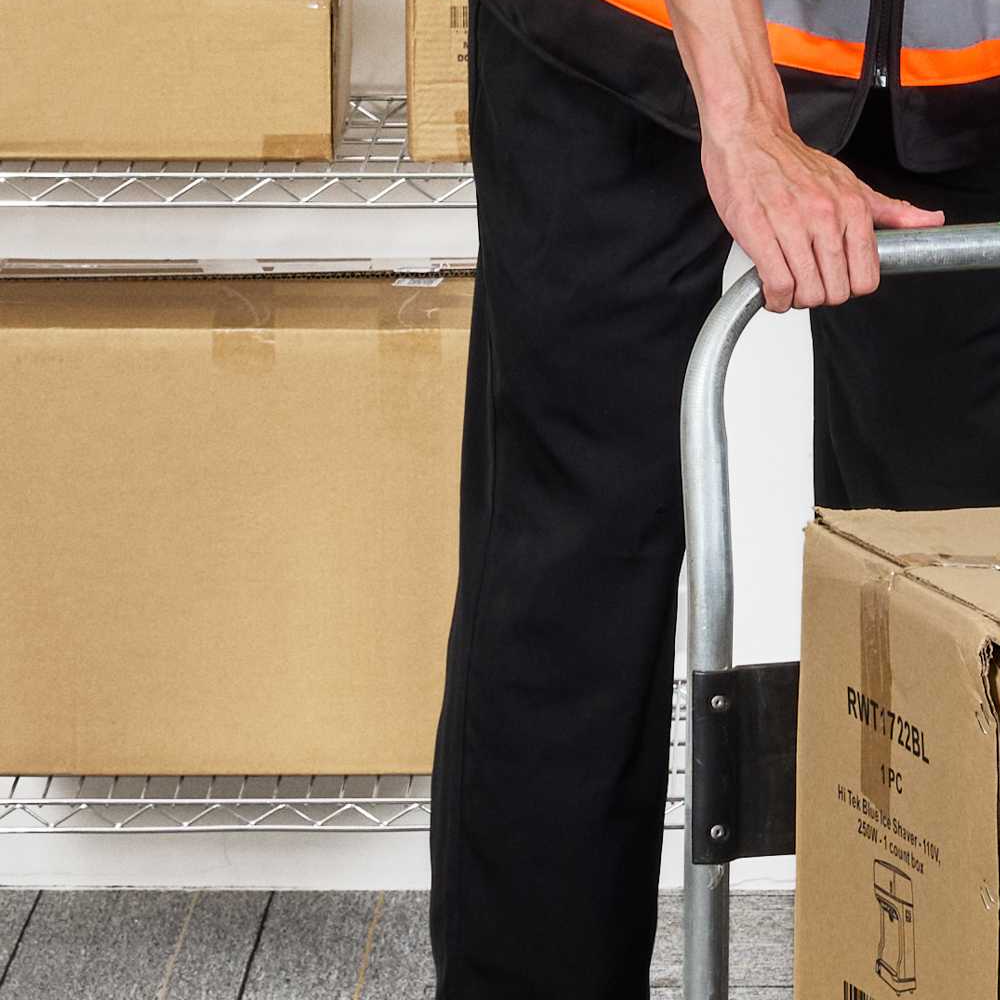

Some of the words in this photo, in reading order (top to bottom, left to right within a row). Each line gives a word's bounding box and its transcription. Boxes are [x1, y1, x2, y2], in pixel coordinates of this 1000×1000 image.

[847, 686, 930, 765] RWT1722BL
[881, 764, 886, 785] 1
[888, 767, 903, 794] PC
[838, 784, 846, 803] Hi
[847, 790, 861, 811] Tek
[862, 798, 879, 822] Blue
[880, 808, 891, 830] Ice
[892, 818, 918, 848] Shaver
[889, 842, 910, 865] count
[911, 851, 924, 874] box
